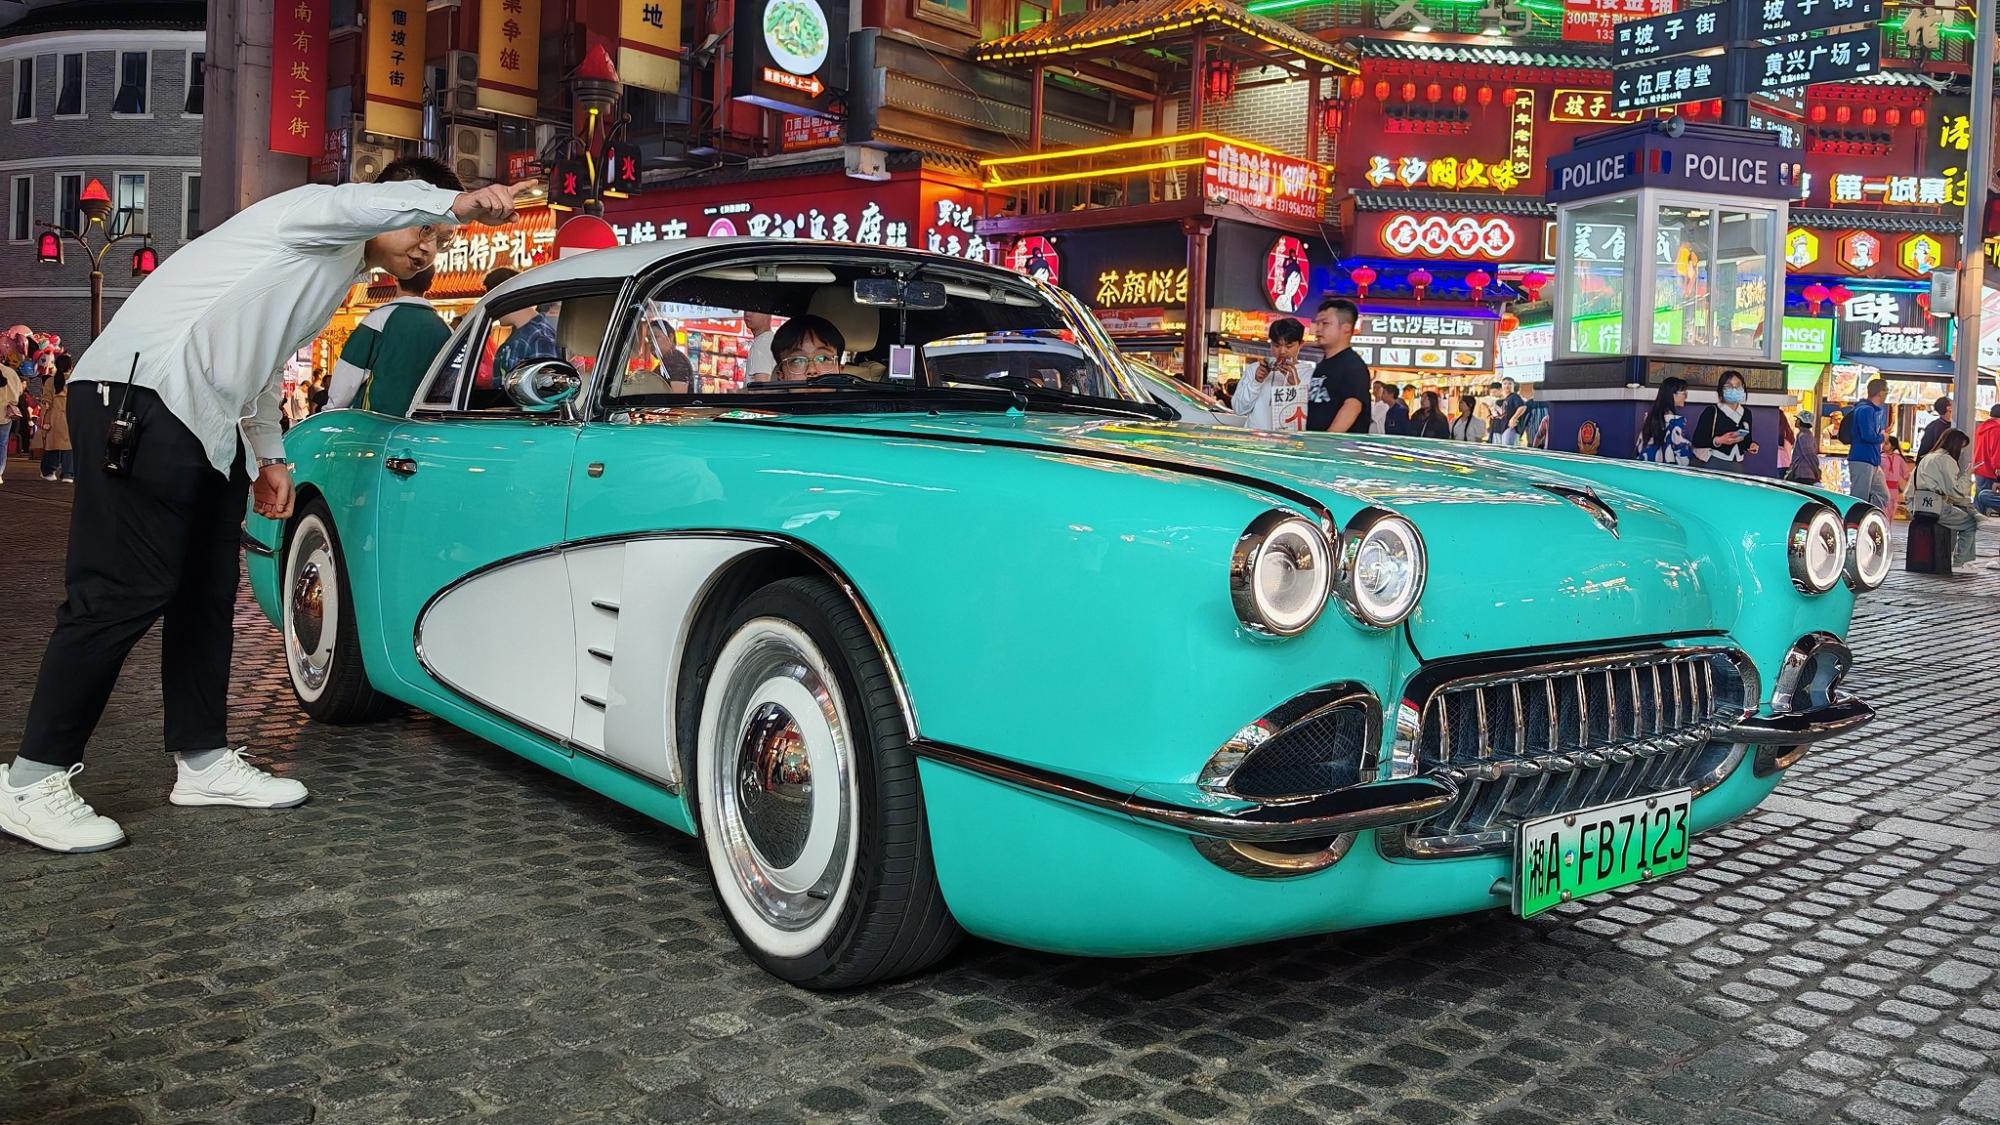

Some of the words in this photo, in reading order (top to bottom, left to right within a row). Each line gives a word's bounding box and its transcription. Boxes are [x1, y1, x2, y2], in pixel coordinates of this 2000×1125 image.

[1619, 28, 1632, 42] 西
[1635, 12, 1717, 46] 坡子街
[1621, 48, 1629, 56] W
[1765, 42, 1851, 76] 黄兴广场
[1636, 64, 1712, 96] 伍厚德堂
[1562, 155, 1624, 190] POLICE
[1685, 153, 1767, 184] POLICE
[1273, 388, 1297, 403] 长沙
[1528, 831, 1561, 900] 湘A
[1577, 802, 1688, 886] FB7123
